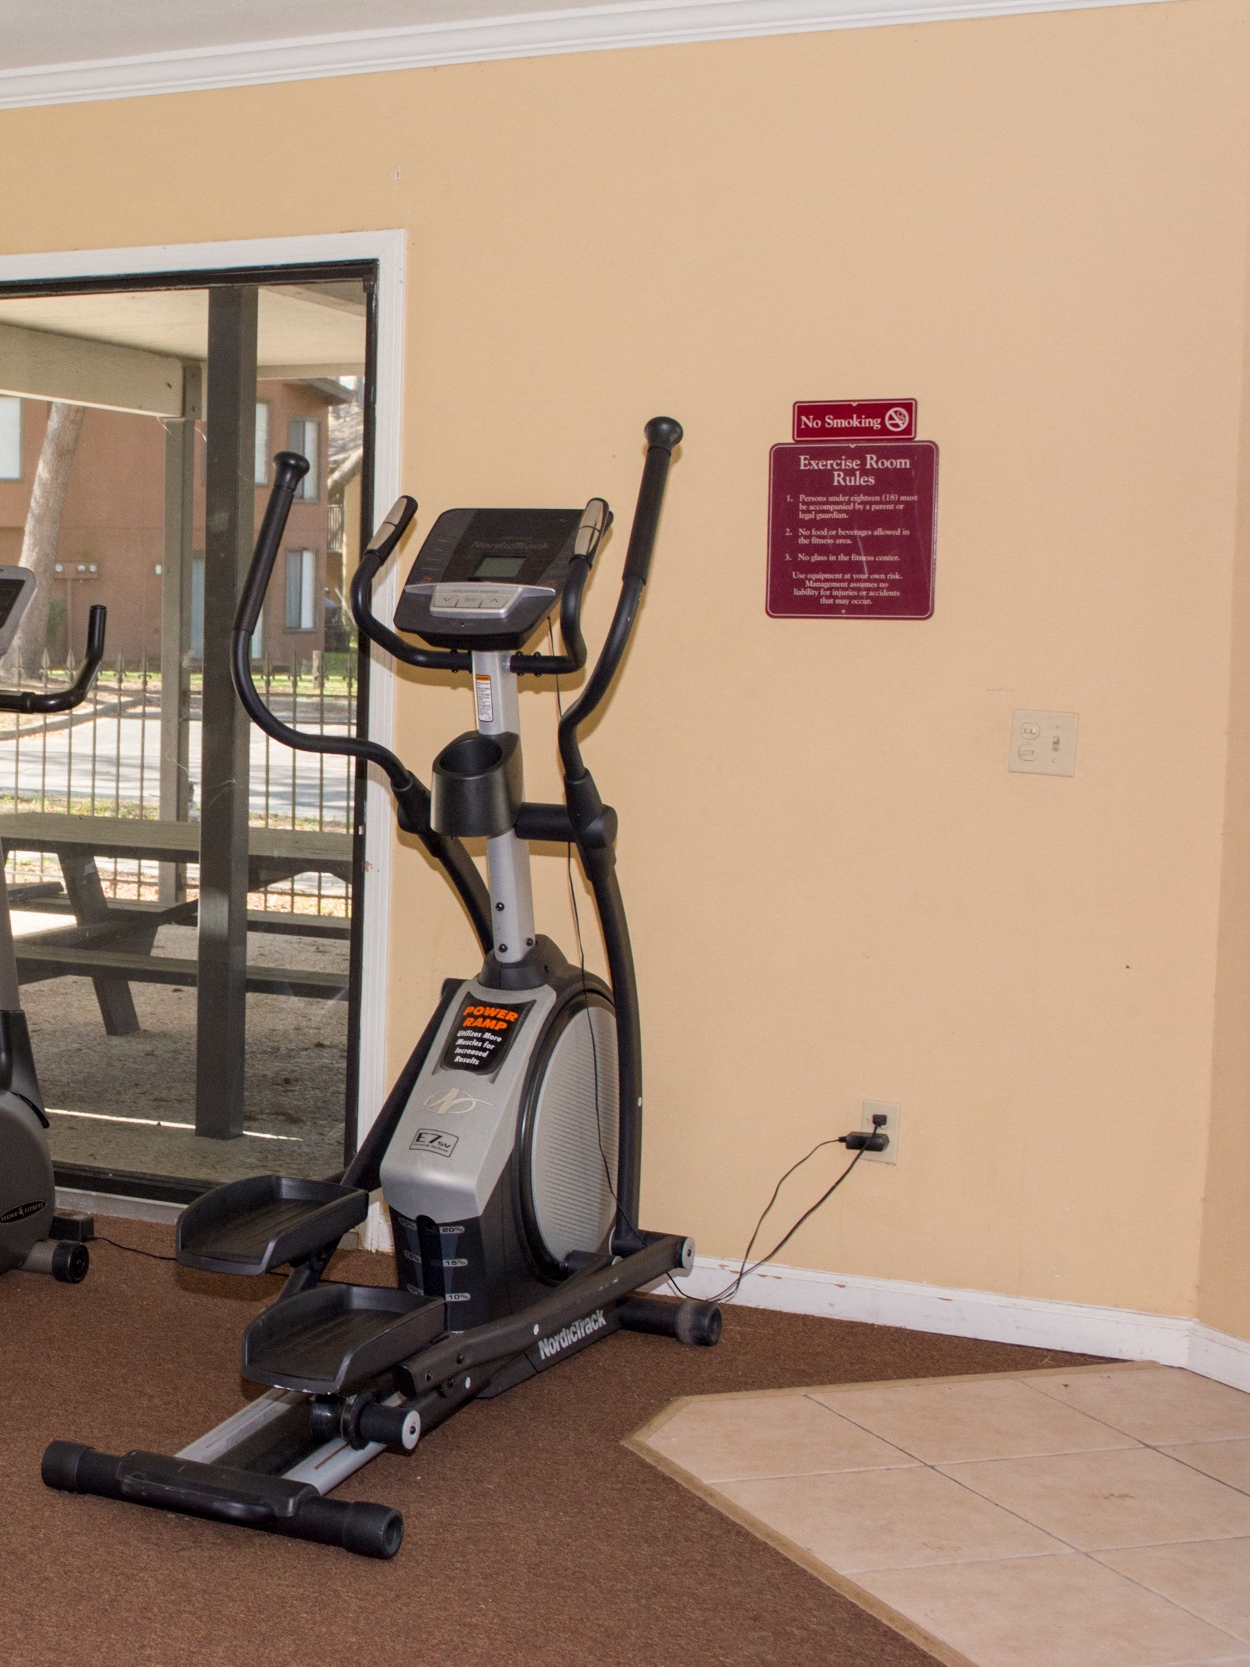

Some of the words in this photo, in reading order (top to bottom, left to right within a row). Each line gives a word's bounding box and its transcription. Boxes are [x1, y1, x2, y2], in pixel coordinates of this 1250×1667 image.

[801, 416, 821, 429] No
[825, 415, 881, 430] Smoking
[799, 455, 860, 470] Exercise
[866, 454, 910, 469] Room
[833, 471, 875, 486] Rules
[800, 494, 826, 502] Persons
[829, 494, 849, 502] under
[851, 494, 880, 503] eighteen
[882, 494, 898, 502] (18)
[809, 503, 853, 511] accompanied
[855, 503, 863, 511] by
[799, 512, 814, 520] legal
[816, 512, 849, 520] guardian.
[799, 528, 810, 536] No
[812, 528, 827, 536] food
[839, 528, 872, 537] beverages
[874, 528, 901, 536] allowed
[903, 528, 910, 536] in
[811, 554, 827, 562] glass
[808, 572, 842, 580] equipment
[805, 580, 848, 588] Management
[794, 588, 818, 597] liability
[820, 588, 830, 596] for
[832, 589, 858, 597] injuries
[463, 1006, 519, 1022] POWER
[463, 1018, 508, 1031] RAMP
[483, 1032, 502, 1042] More
[456, 1039, 482, 1047] Muscles
[483, 1041, 495, 1050] for
[455, 1048, 489, 1058] Increased
[454, 1056, 479, 1065] Results
[538, 1309, 607, 1360] NordicTrack
